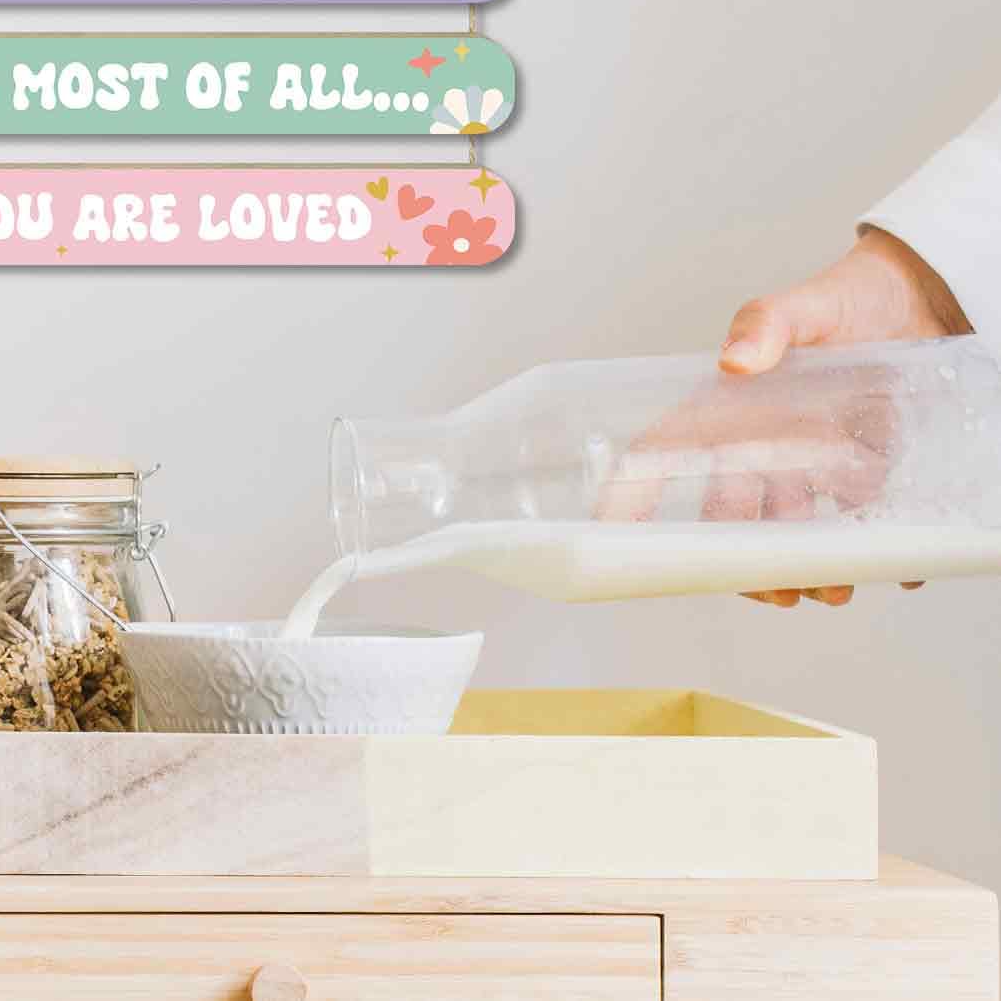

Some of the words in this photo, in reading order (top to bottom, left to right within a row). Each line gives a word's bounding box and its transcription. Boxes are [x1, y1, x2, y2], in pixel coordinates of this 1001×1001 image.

[12, 62, 167, 111] MOST
[185, 62, 250, 111] OF
[268, 62, 430, 111] ALL...
[72, 193, 180, 242] ARE
[198, 193, 373, 242] LOVED
